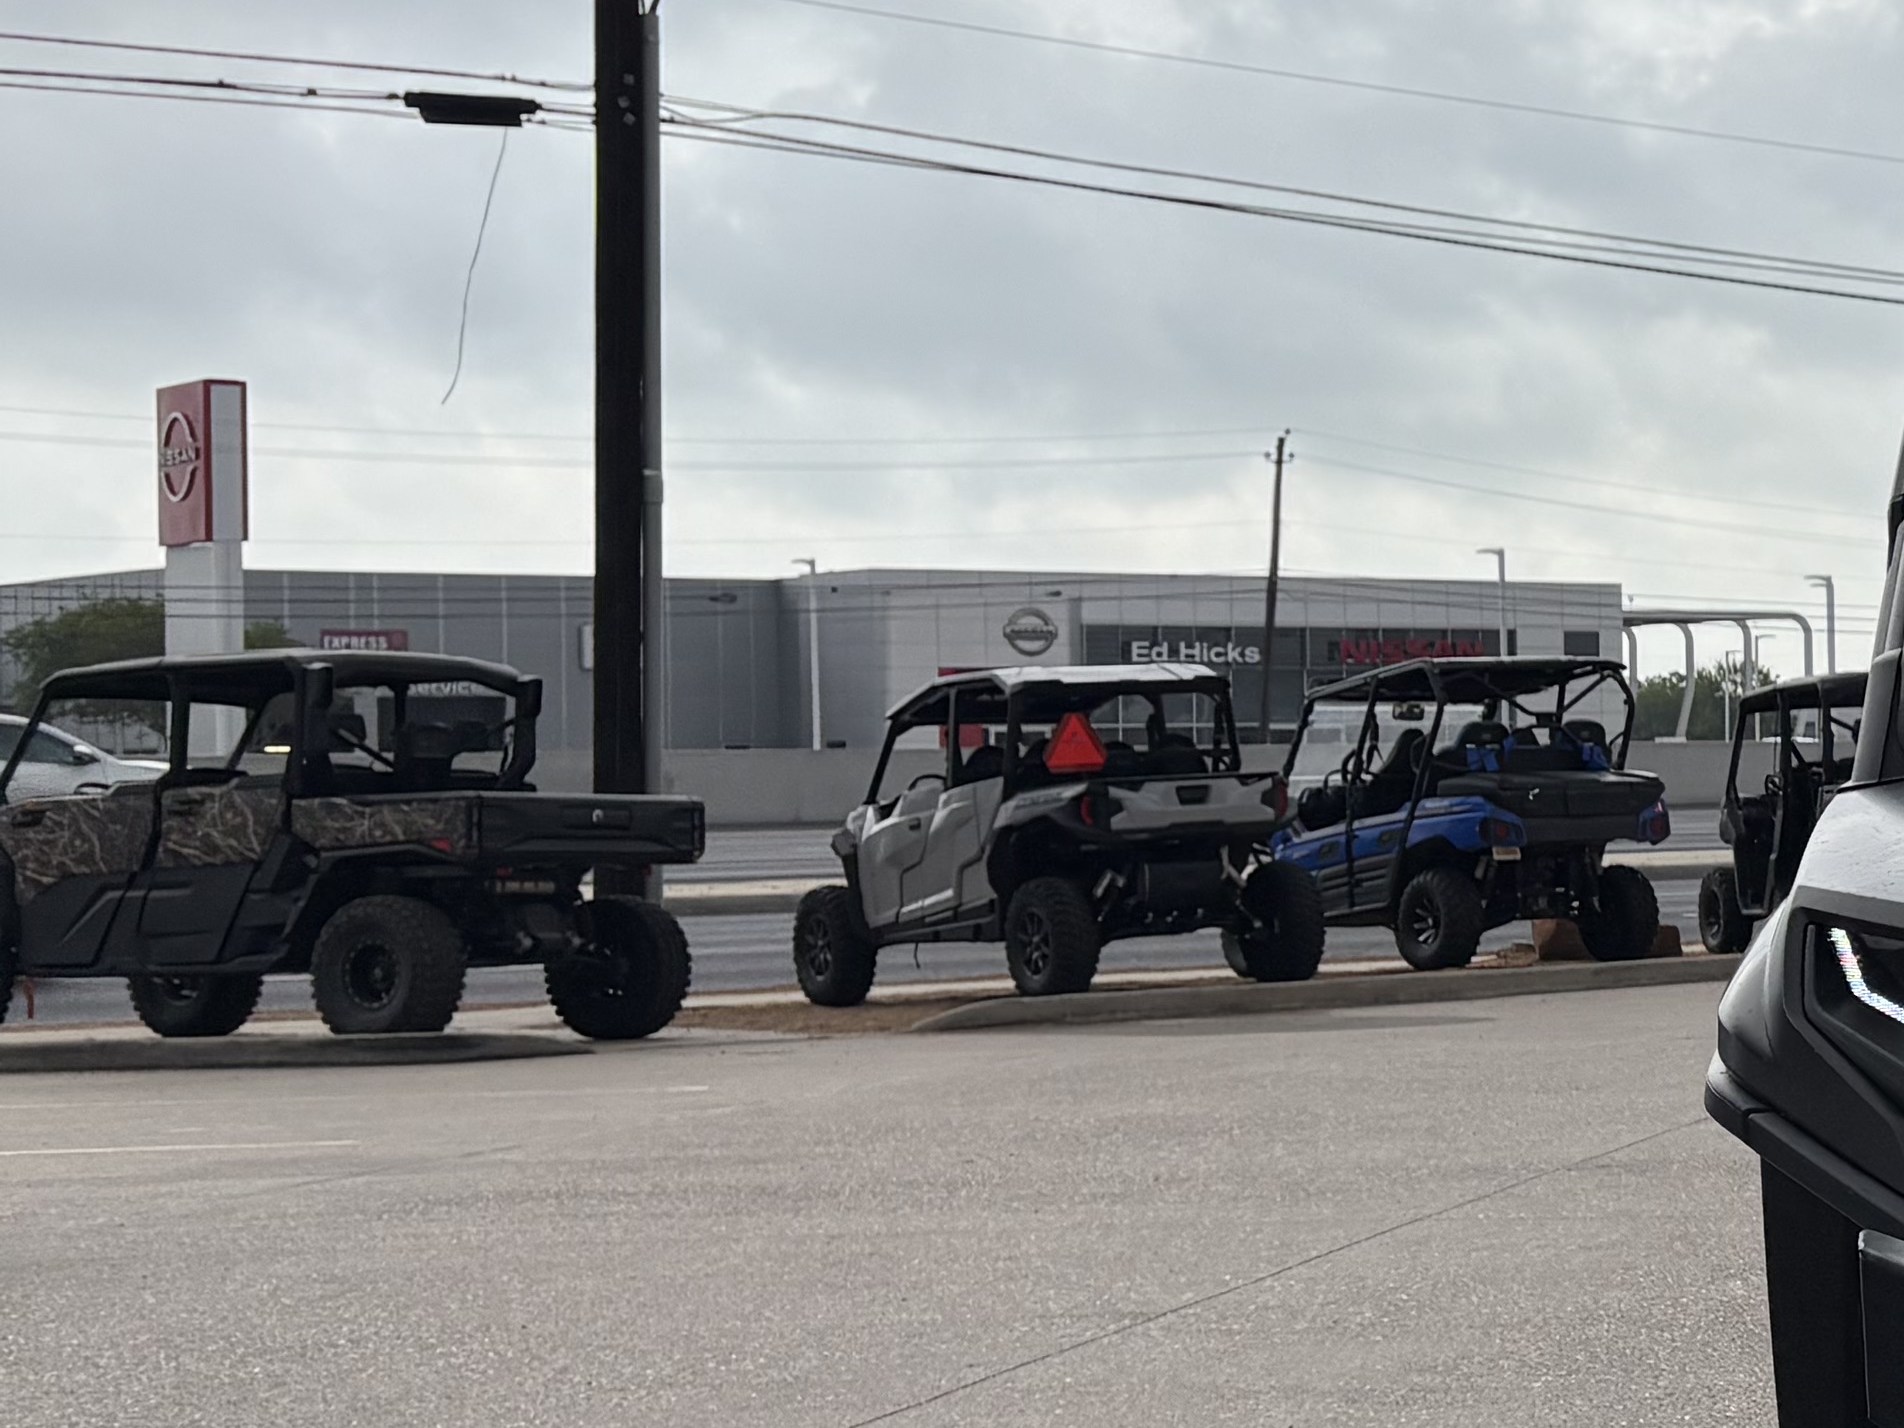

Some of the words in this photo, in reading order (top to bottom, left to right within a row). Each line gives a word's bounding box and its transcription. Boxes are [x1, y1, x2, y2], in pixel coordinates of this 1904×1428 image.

[323, 635, 388, 649] EXPRESS
[1131, 641, 1169, 662] Ed
[1179, 642, 1261, 663] Hicks
[1339, 639, 1484, 664] NISSAN
